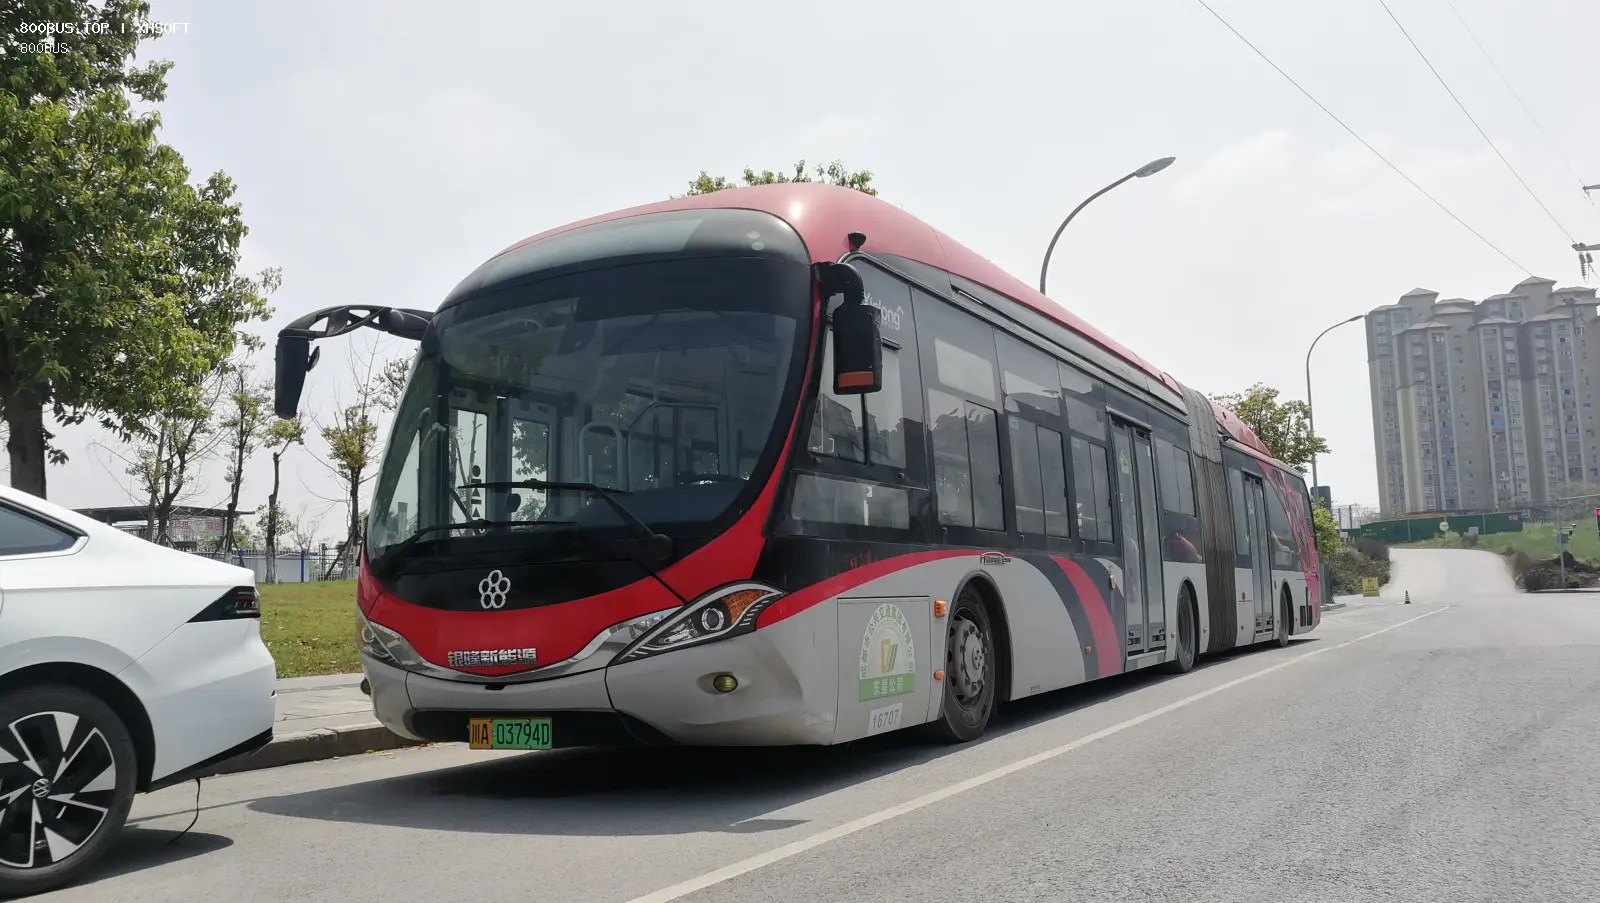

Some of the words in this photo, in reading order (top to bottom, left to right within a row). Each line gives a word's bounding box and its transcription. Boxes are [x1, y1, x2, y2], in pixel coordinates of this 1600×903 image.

[448, 648, 537, 667] 银隆新能源
[872, 709, 900, 730] 16707
